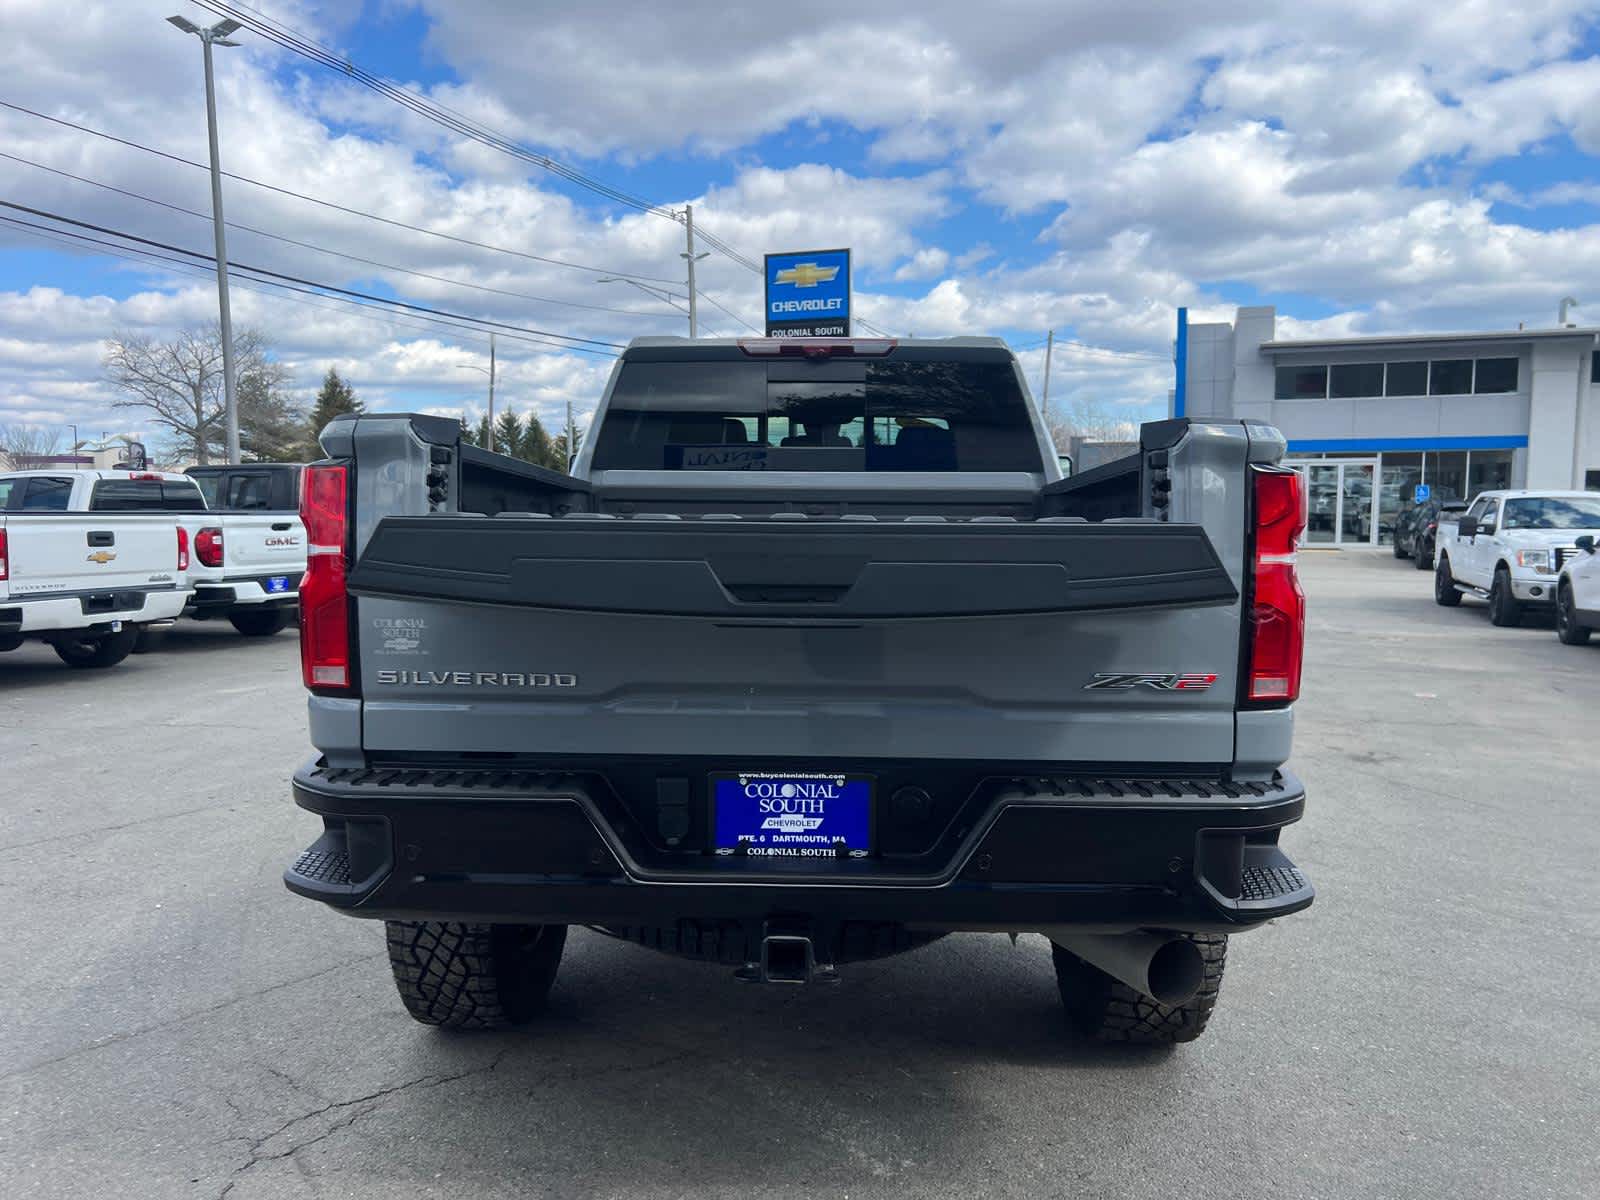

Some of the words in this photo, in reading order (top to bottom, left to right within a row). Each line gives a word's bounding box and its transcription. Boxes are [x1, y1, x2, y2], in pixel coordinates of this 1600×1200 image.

[771, 298, 843, 313] CHEVROLET
[771, 328, 812, 337] COLONIAL
[815, 327, 843, 336] SOUTH
[265, 537, 299, 546] GMC
[373, 618, 428, 629] COLONIAL
[383, 628, 420, 638] SOUTH
[377, 670, 577, 687] SILVERADO
[1083, 673, 1219, 690] ZR2
[738, 772, 846, 780] www.buycolonialsouth.com
[744, 784, 840, 799] COLONIAL
[759, 799, 825, 813] SOUTH
[767, 819, 817, 827] CHEVROLET
[772, 835, 830, 843] DARTMOUTH,
[747, 848, 799, 856] COLONIAL
[801, 848, 836, 857] SOUTH
